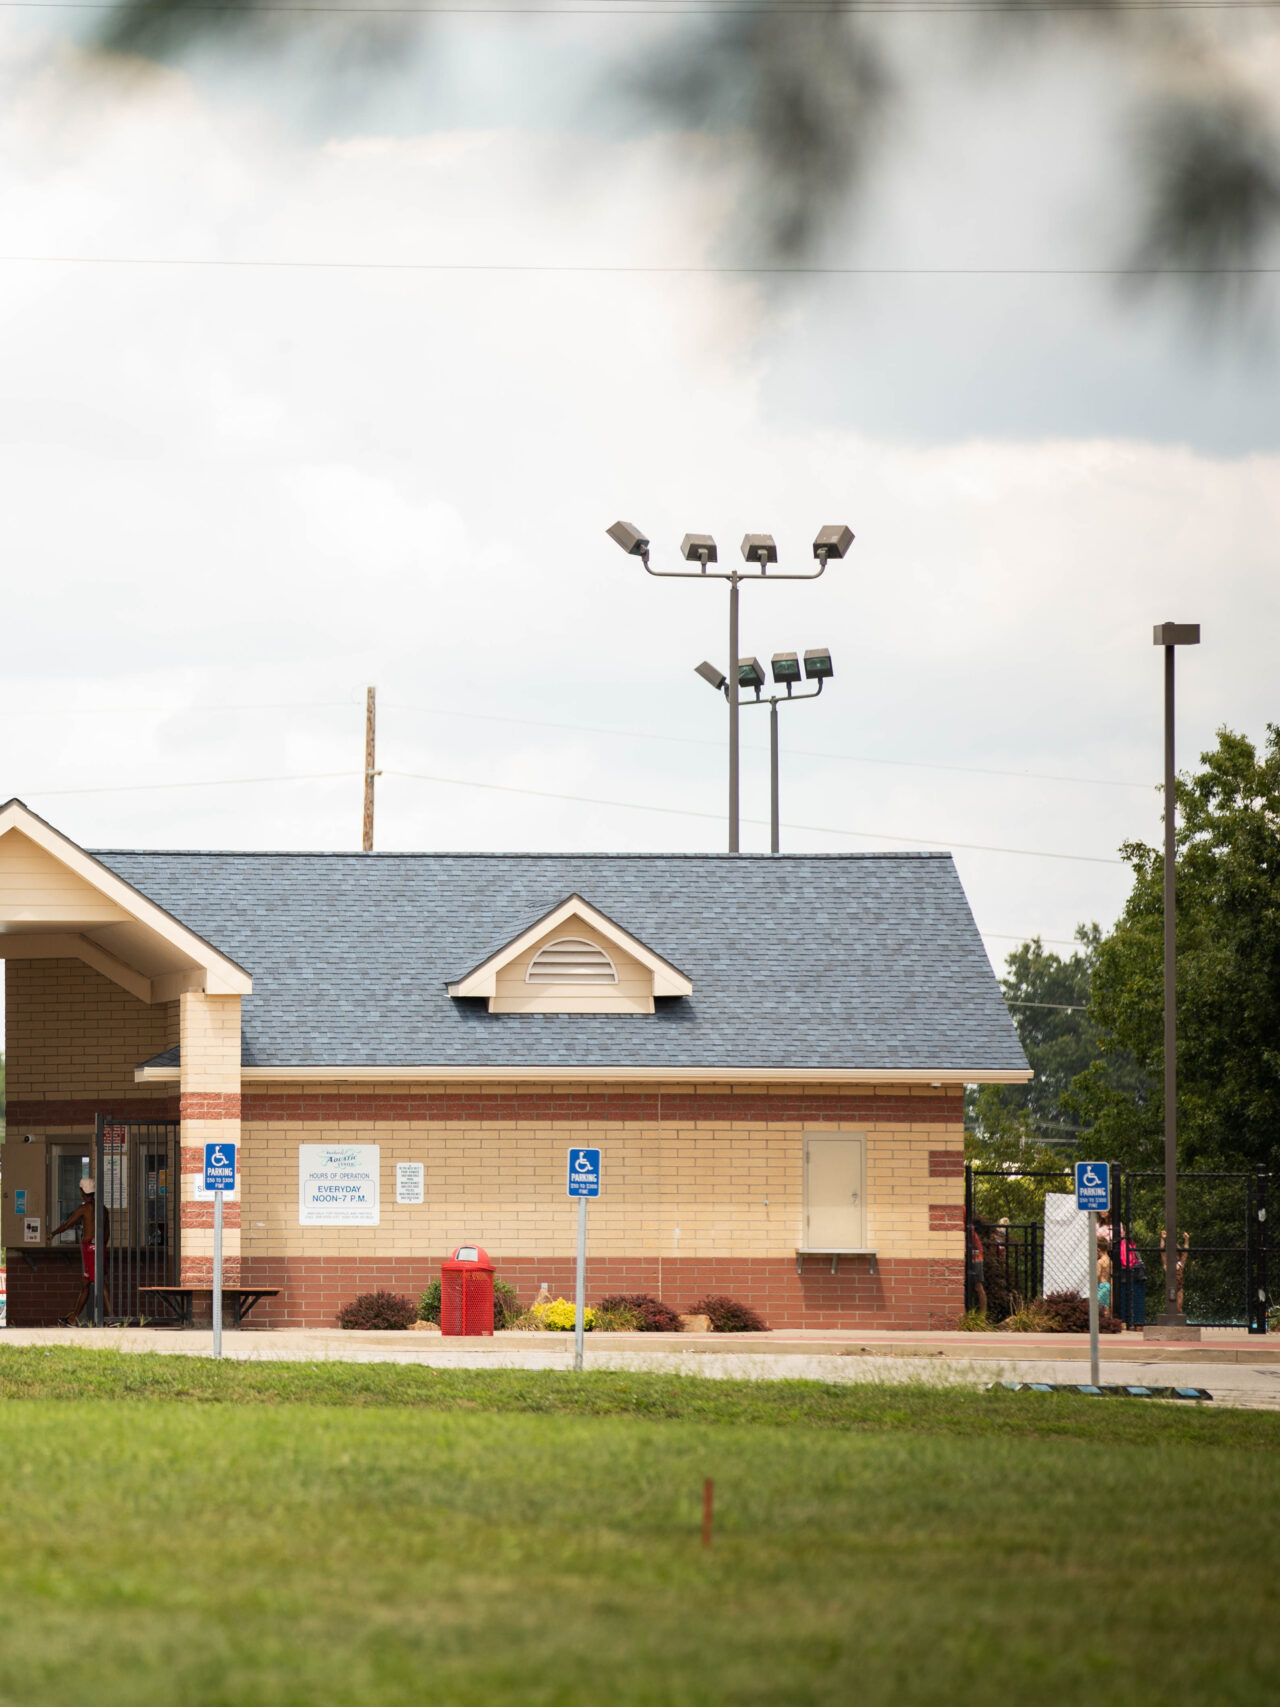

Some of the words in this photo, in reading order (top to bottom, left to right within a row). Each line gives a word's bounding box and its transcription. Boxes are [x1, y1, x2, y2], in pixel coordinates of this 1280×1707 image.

[207, 1167, 233, 1177] PARKING
[309, 1172, 328, 1180] HOURS
[330, 1172, 338, 1180] OF
[340, 1172, 370, 1180] OPERATION
[571, 1173, 597, 1182] PARKING
[317, 1185, 361, 1193] EVERYDAY
[1080, 1187, 1106, 1196] PARKING
[312, 1194, 347, 1203] NOON-7
[350, 1194, 368, 1203] P.M.
